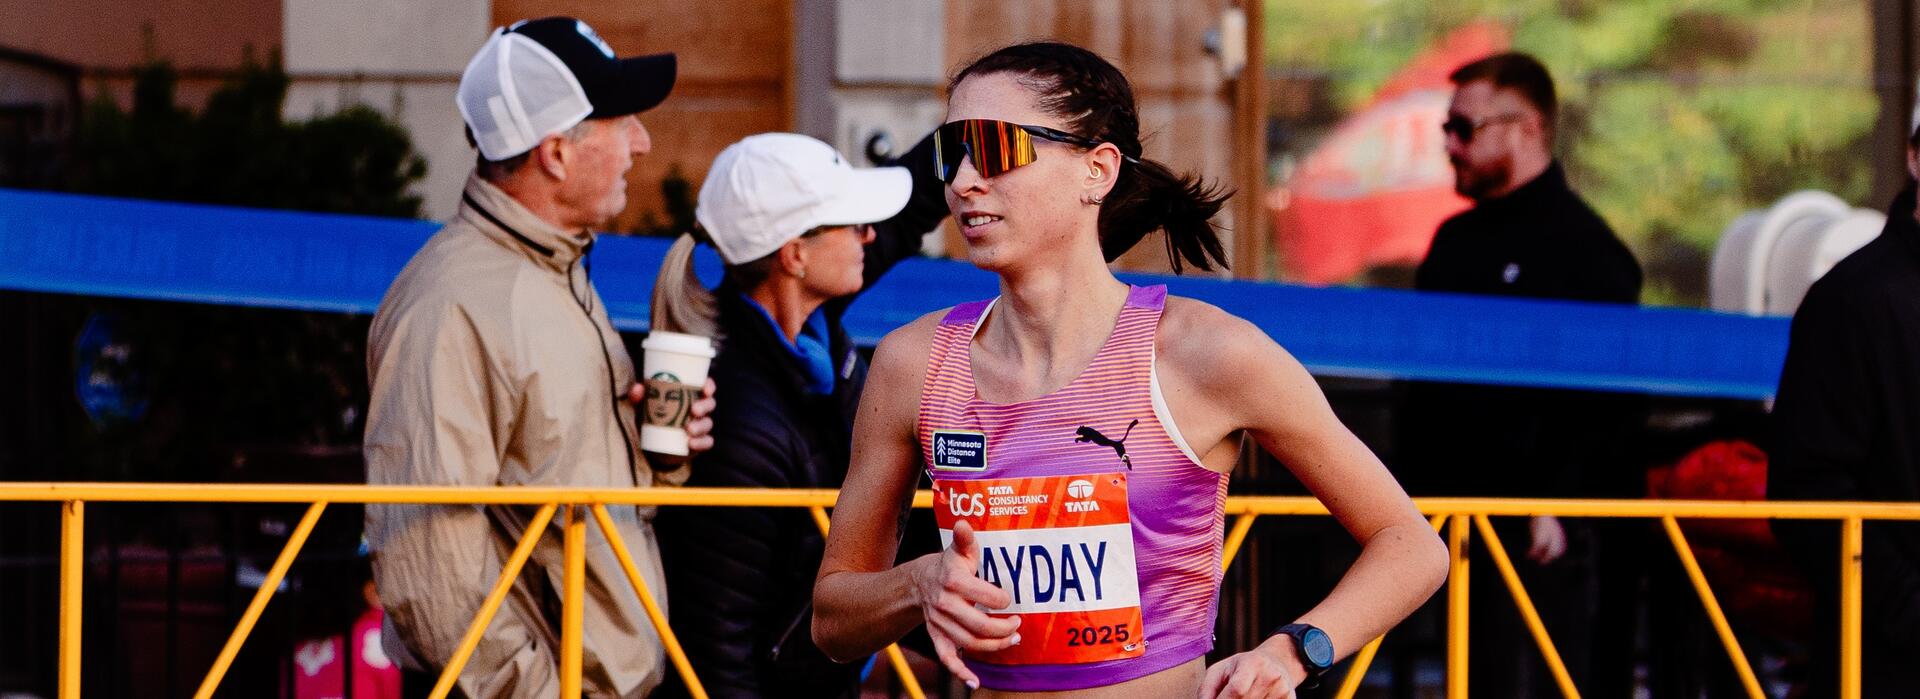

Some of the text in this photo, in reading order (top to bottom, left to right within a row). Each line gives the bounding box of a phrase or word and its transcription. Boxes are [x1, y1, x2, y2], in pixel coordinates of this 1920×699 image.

[947, 439, 982, 449] Minnesota
[947, 447, 976, 457] Distance
[947, 456, 961, 465] Elite
[987, 486, 1014, 496] TATA
[949, 487, 986, 517] tcs
[988, 494, 1049, 506] CONSULTANCY
[989, 505, 1029, 516] SERVICES
[1065, 500, 1100, 513] TATA
[974, 541, 1107, 605] AYDAY
[1067, 624, 1129, 647] 2025
